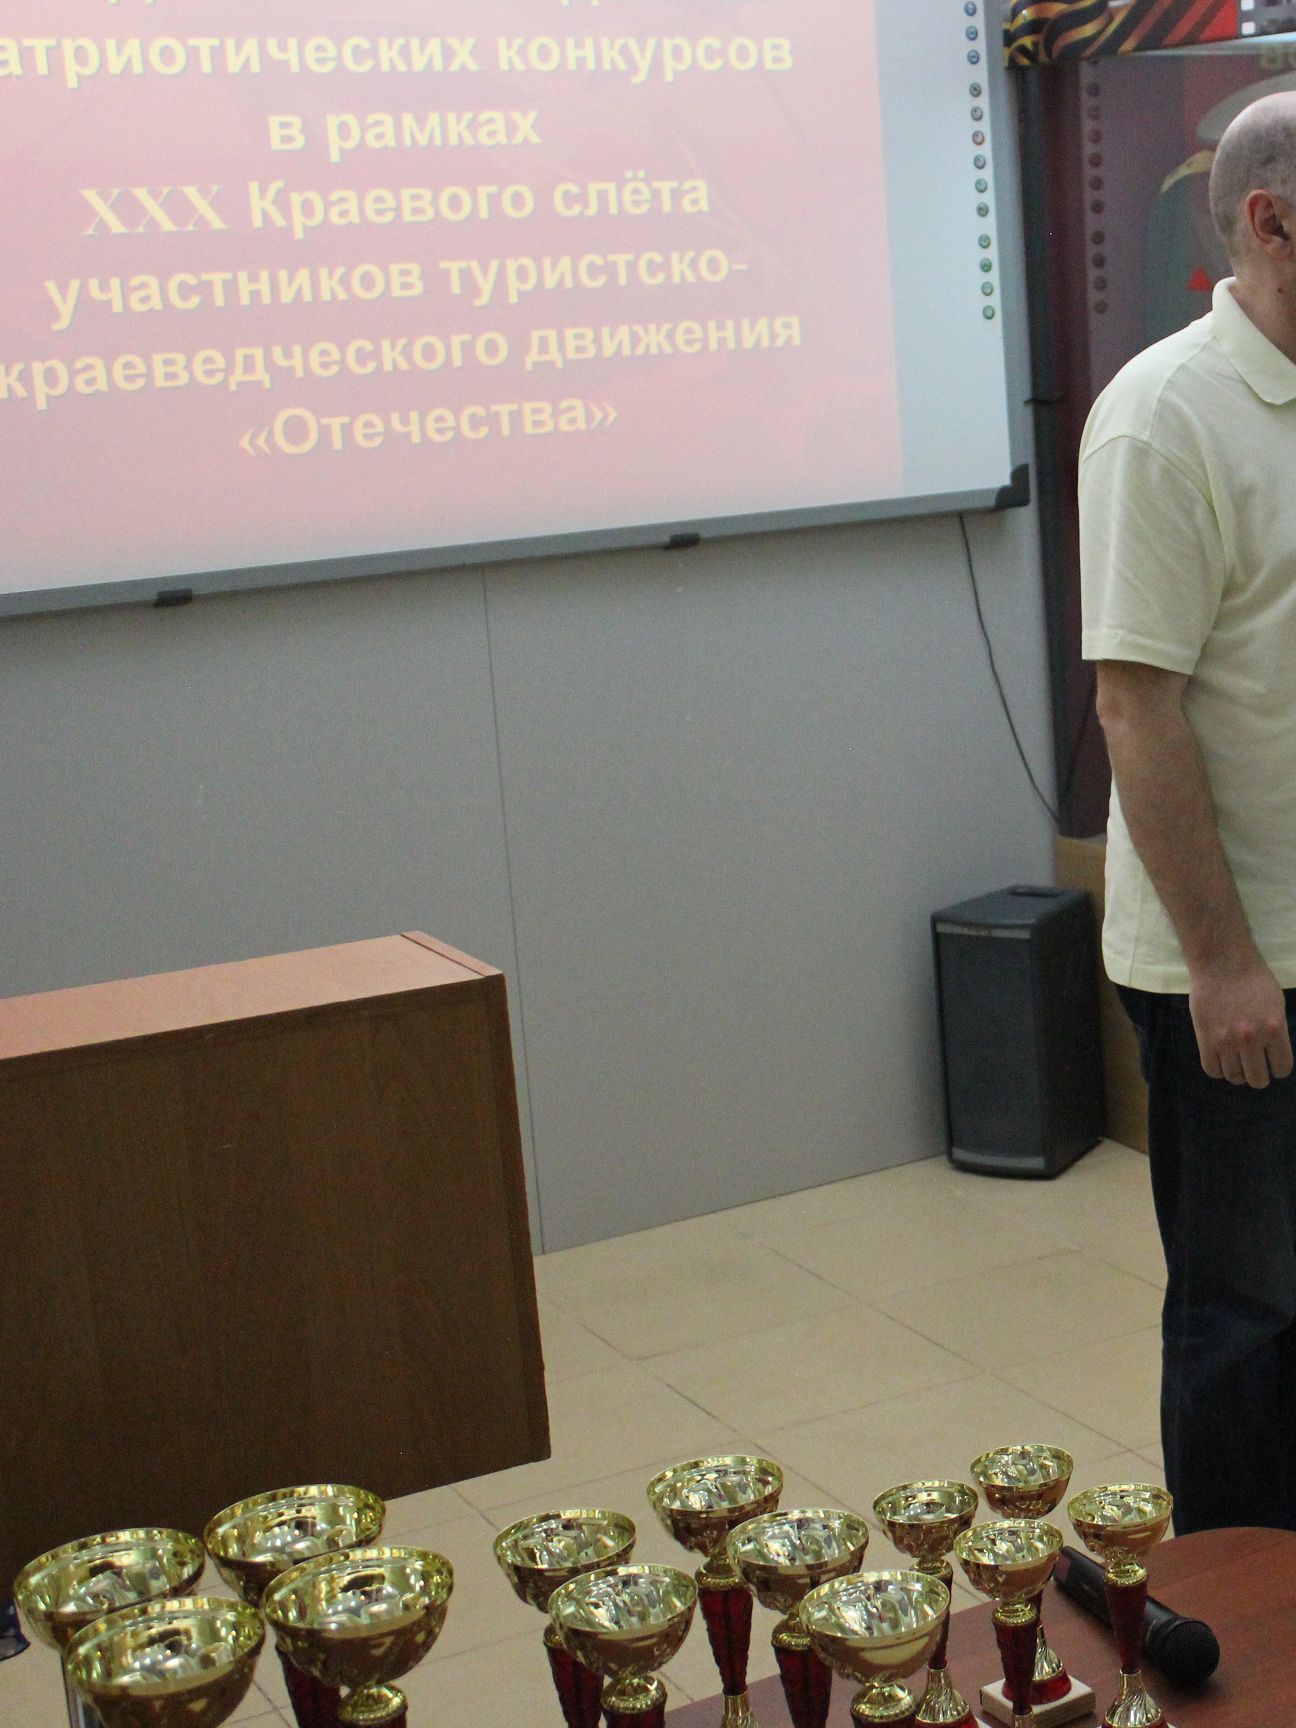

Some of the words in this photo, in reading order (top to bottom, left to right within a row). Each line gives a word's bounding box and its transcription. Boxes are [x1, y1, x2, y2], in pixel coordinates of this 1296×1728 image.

[498, 36, 795, 84] конкурсов
[268, 114, 306, 151] в
[325, 106, 543, 163] рамках
[249, 179, 536, 240] Краевого
[553, 170, 710, 218] слёта
[45, 257, 424, 331] участников
[440, 249, 749, 307] туристско-
[0, 331, 509, 410] краеведческого
[526, 316, 802, 371] движения
[238, 398, 620, 458] «Отечества»
